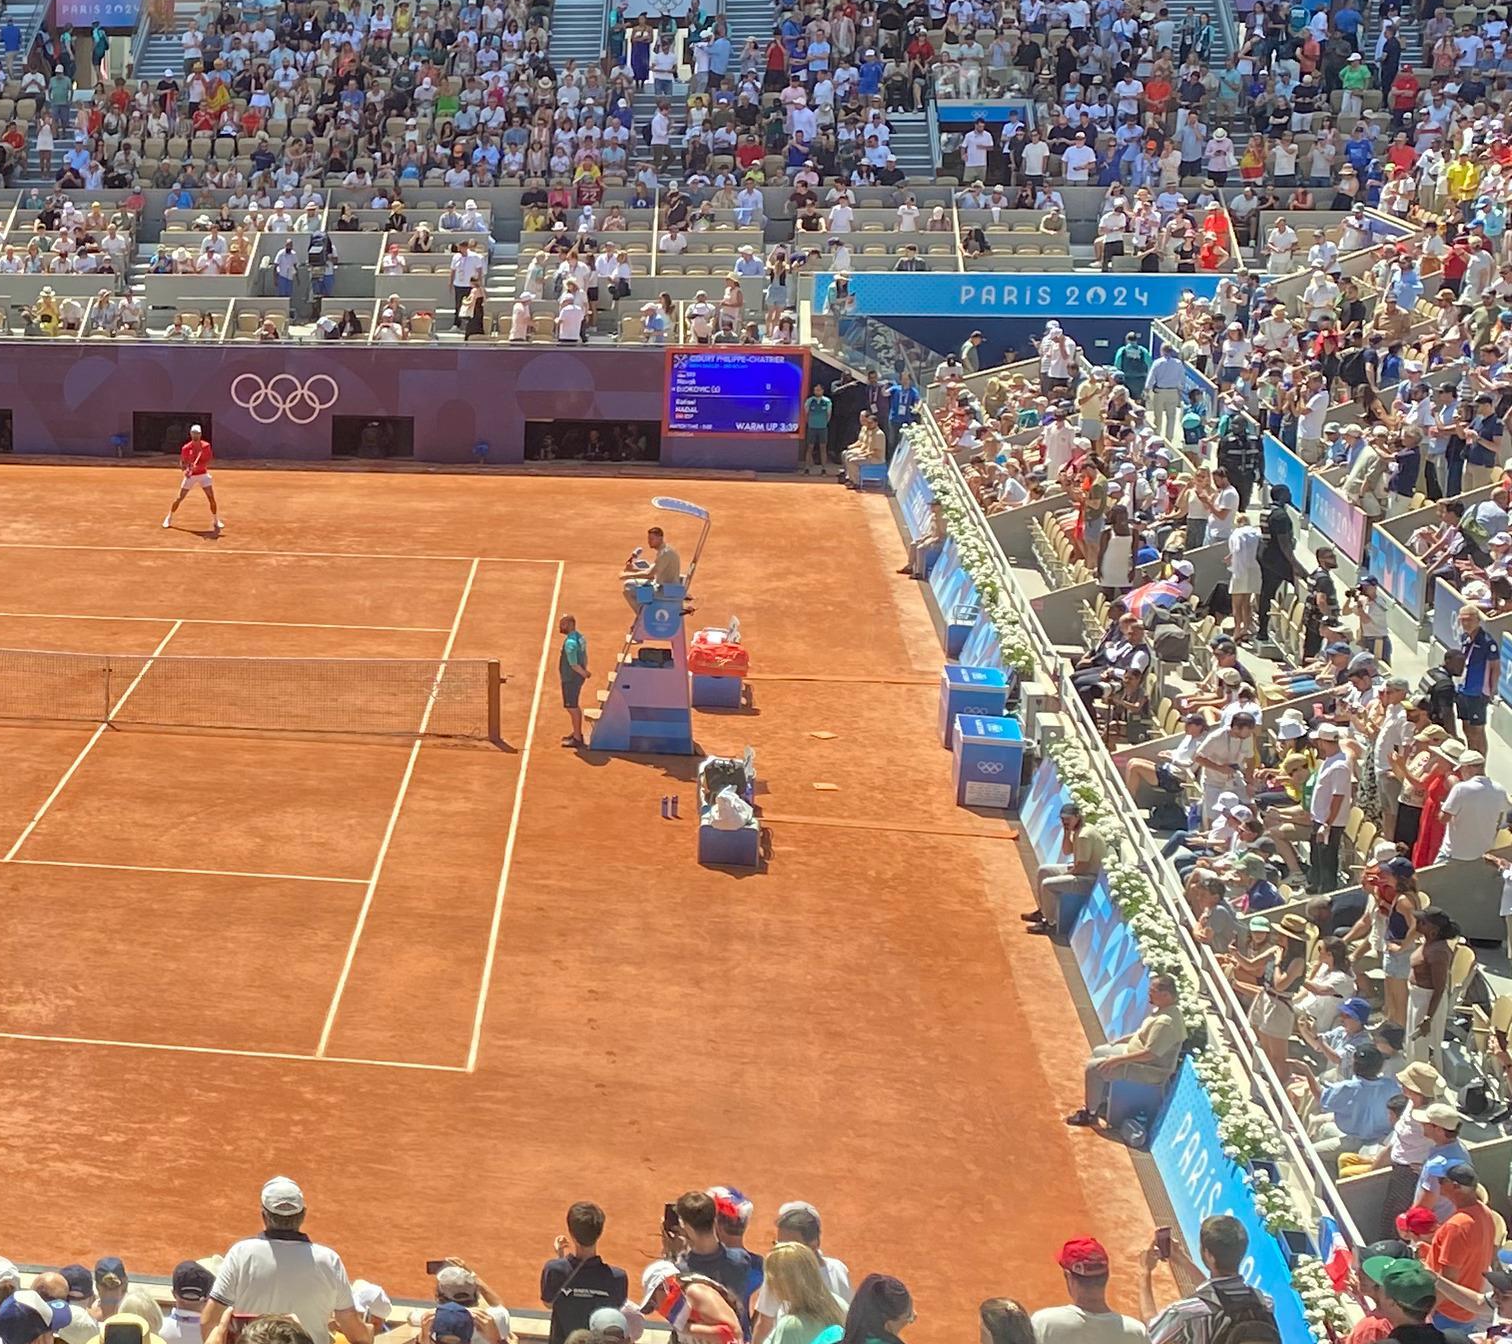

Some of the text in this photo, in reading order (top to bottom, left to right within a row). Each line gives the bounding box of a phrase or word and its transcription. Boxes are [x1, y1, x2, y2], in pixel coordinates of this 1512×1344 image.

[62, 4, 101, 15] PARIS
[582, 191, 597, 201] 22
[960, 284, 1149, 307] PARIS 2024
[735, 421, 799, 433] WARM UP 3:39
[1170, 1111, 1223, 1225] PARIS
